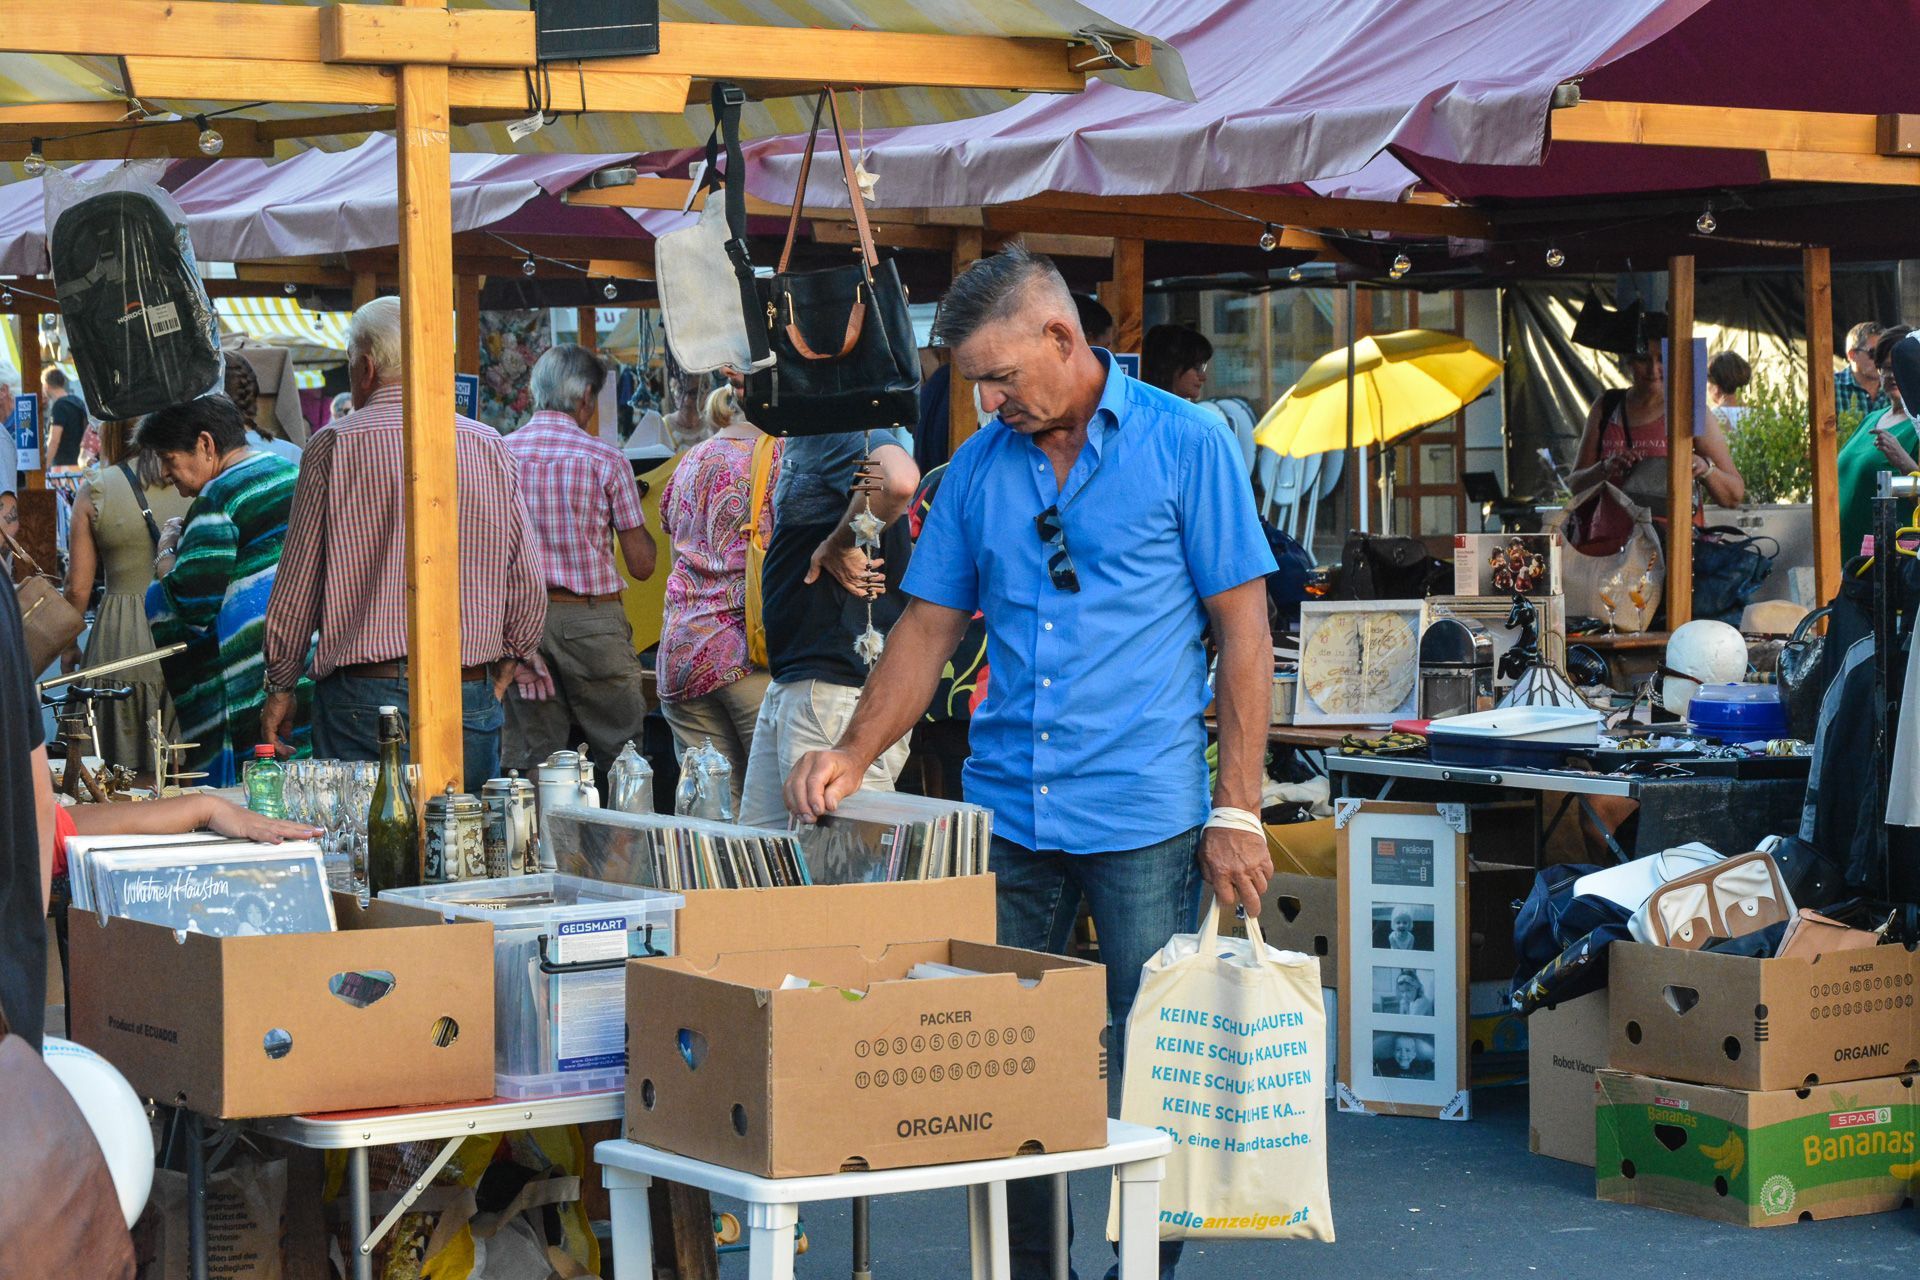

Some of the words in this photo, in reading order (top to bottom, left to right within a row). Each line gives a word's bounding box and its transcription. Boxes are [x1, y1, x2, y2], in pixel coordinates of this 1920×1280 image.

[123, 875, 173, 910] Whitney
[173, 872, 229, 902] Houston
[561, 919, 623, 934] GEOSMART
[1850, 963, 1874, 973] PACKER
[920, 1010, 972, 1026] PACKER
[1160, 1007, 1208, 1026] KEINE
[1212, 1015, 1257, 1037] SCHU
[144, 1024, 178, 1044] ECUADOR
[1155, 1036, 1205, 1056] KEINE
[1208, 1044, 1254, 1066] SCHU
[1255, 1041, 1308, 1062] KAUFEN
[1834, 1042, 1890, 1062] ORGANIC
[1553, 1055, 1575, 1070] Robot
[1151, 1065, 1201, 1086] KEINE
[1257, 1070, 1312, 1091] KAUFEN
[1162, 1096, 1211, 1118] KEINE
[1660, 1097, 1680, 1107] SPAR
[896, 1112, 993, 1138] ORGANIC
[1647, 1105, 1698, 1128] Bananas
[1838, 1112, 1876, 1125] SPAR
[1188, 1132, 1221, 1149] eine
[1224, 1131, 1312, 1153] Handtasche.
[1803, 1131, 1916, 1168] Bananas
[1159, 1206, 1309, 1231] ndleanzeiger.at
